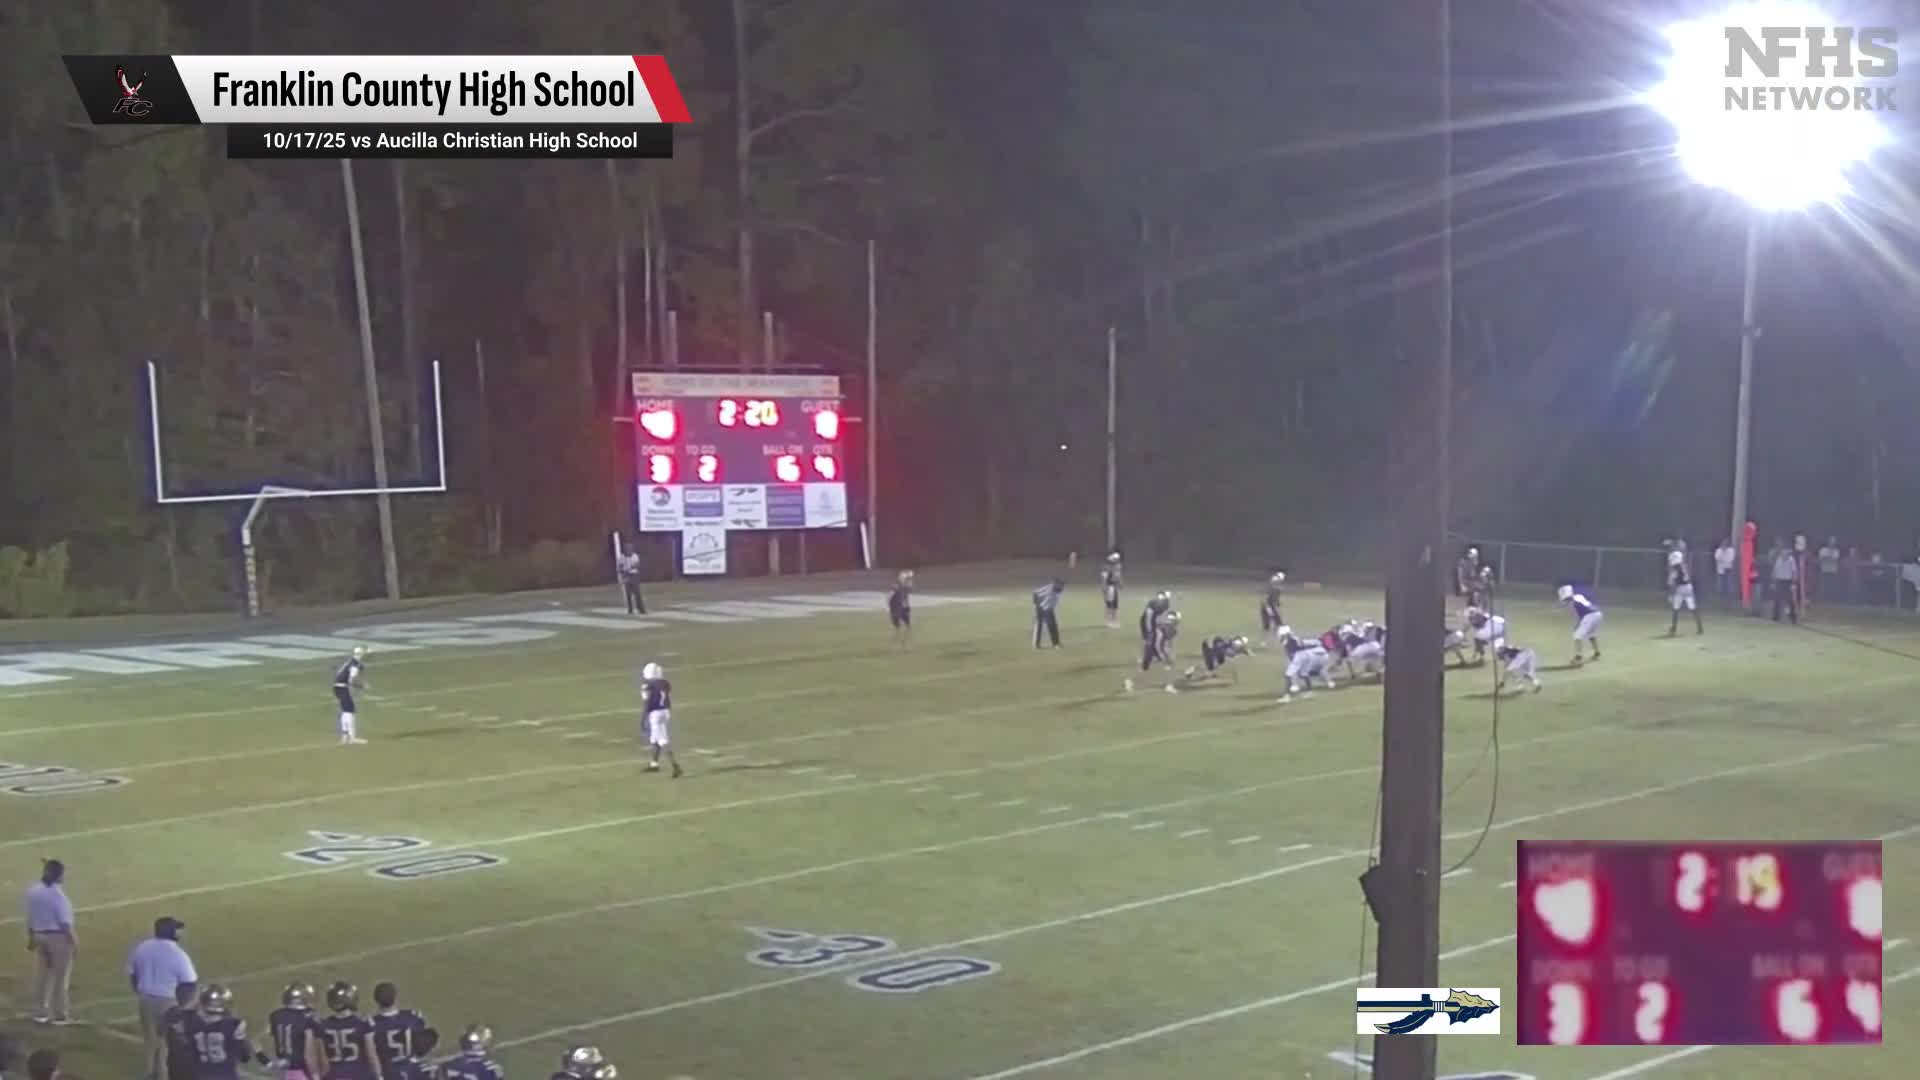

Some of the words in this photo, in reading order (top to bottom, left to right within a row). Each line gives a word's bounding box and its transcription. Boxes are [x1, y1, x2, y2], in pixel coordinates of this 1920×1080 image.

[636, 400, 674, 412] HOME
[719, 400, 779, 426] 2:20
[801, 401, 841, 412] GUEST
[641, 446, 675, 455] DOWN
[686, 445, 699, 455] TO
[763, 445, 787, 455] BALL
[699, 455, 717, 482] 2
[776, 455, 800, 482] 6
[814, 455, 836, 480] 4
[281, 832, 510, 881] 20
[746, 929, 1002, 993] 30
[324, 1027, 359, 1061] 35
[386, 1026, 412, 1062] 51
